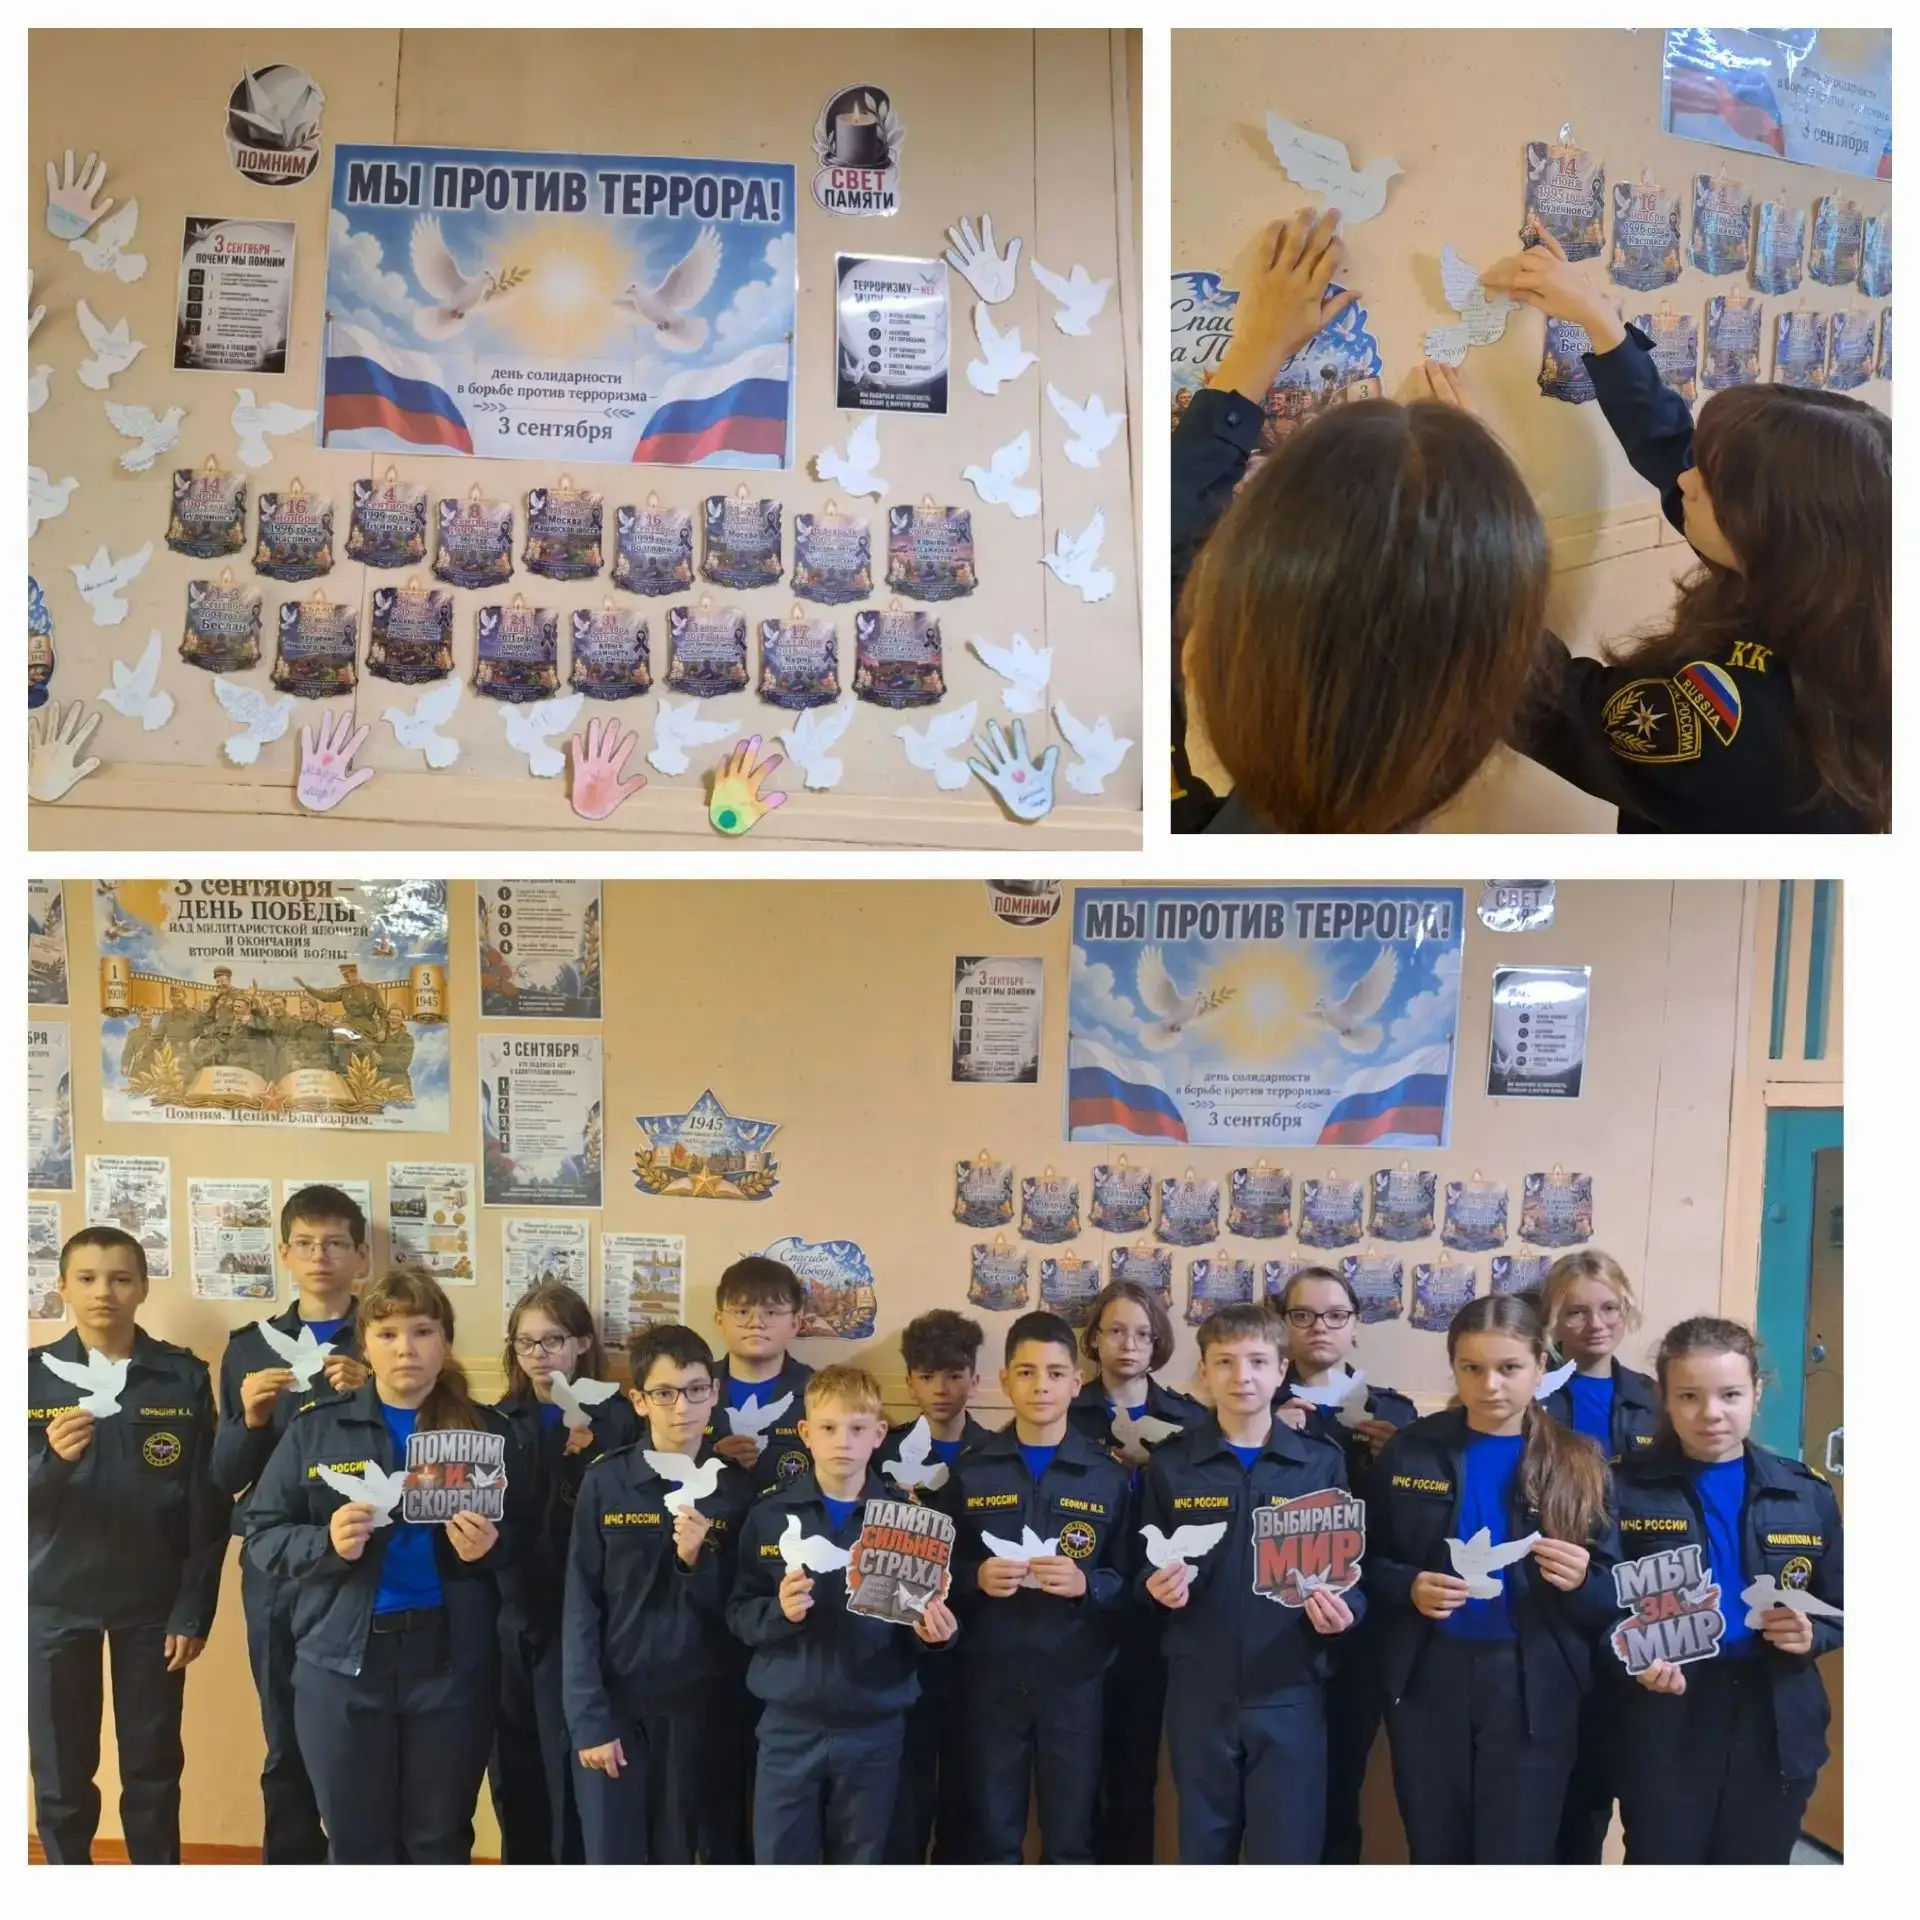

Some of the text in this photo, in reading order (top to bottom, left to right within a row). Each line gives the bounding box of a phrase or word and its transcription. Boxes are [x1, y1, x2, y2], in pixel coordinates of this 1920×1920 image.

[1801, 119, 1870, 155] 3 сентября
[236, 149, 306, 175] ПОМНИМ
[1559, 155, 1577, 176] 14
[831, 168, 886, 191] СВЕТ
[348, 163, 781, 222] МЫ ПРОТИВ ТЕРРОРА!
[823, 188, 894, 210] ПАМЯТИ
[1538, 187, 1566, 201] 1995
[1640, 193, 1656, 211] 16
[1624, 222, 1646, 235] 1996
[214, 235, 271, 255] 3 СЕНТЯБРЯ
[195, 252, 286, 268] ПОЧЕМУ МЫ ПОМНИМ
[853, 279, 936, 296] ТЕРРОРИЗМУ НЕТ
[1559, 328, 1580, 339] 2004
[491, 367, 622, 384] день солидарности
[457, 381, 647, 403] в борьбе против терроризма
[1359, 384, 1370, 398] 3
[498, 417, 614, 443] 3 сентября
[384, 487, 396, 502] 4
[287, 500, 307, 514] 16
[362, 510, 409, 522] 1999 года
[548, 516, 582, 526] Москва
[646, 514, 661, 526] 16
[270, 525, 319, 535] 1996 года
[200, 620, 247, 634] Беслан
[790, 625, 809, 639] 17
[34, 638, 42, 650] 3
[1725, 640, 1774, 673] КК
[1682, 678, 1721, 728] RUSSIA
[1676, 701, 1694, 752] РОССИИ
[175, 880, 334, 899] 3 сентября
[994, 896, 1052, 916] ПОМНИМ
[1495, 890, 1542, 907] СВЕТ
[177, 900, 357, 923] ДЕНЬ ПОБЕДЫ
[1085, 903, 1146, 939] МЫ
[1155, 903, 1285, 940] ПРОТИВ
[1295, 902, 1452, 940] ТЕРРОРА!
[168, 923, 369, 937] НАД МИЛИТАРИСТСКОЙ ЯПОНИЕЙ
[225, 936, 311, 947] И ОКОНЧАНИЯ
[188, 946, 348, 960] ВТОРОЙ МИРОВОЙ ВОЙНЫ
[110, 963, 119, 979] 1
[422, 971, 431, 986] 3
[978, 970, 987, 986] 3
[106, 988, 128, 1001] 1939
[993, 987, 1005, 996] МЫ
[415, 993, 439, 1009] 1945
[502, 1041, 580, 1058] 3 СЕНТЯБРЯ
[1203, 1072, 1311, 1084] день солидарности
[1184, 1084, 1222, 1098] борьбе
[1223, 1087, 1264, 1098] против
[1266, 1087, 1332, 1098] терроризма
[165, 1106, 374, 1126] Помним. Ценим. Благодарим.
[689, 1116, 724, 1131] 1945
[1208, 1111, 1303, 1130] 3 сентября
[780, 1247, 828, 1264] Спасибо
[410, 1433, 502, 1468] ПОМНИМ
[331, 1460, 369, 1473] РОССИИ
[444, 1464, 467, 1488] И
[1391, 1475, 1450, 1493] МЧС РОССИИ
[406, 1488, 502, 1518] СКОРБИМ
[967, 1493, 1018, 1509] МЧС РОССИИ
[1174, 1496, 1229, 1509] МЧС РОССИИ
[604, 1513, 661, 1526] МЧС РОССИИ
[863, 1500, 953, 1542] ПАМЯТЬ
[1260, 1503, 1360, 1537] ВЫБИРАЕМ
[1620, 1519, 1688, 1532] МЧС РОССИИ
[760, 1544, 780, 1556] МЧС
[861, 1525, 951, 1567] СИЛЬНЕЕ
[1259, 1530, 1362, 1588] МИР
[859, 1547, 942, 1591] СТРАХА
[1617, 1545, 1702, 1605] МЫ
[1638, 1592, 1683, 1622] ЗА
[1624, 1608, 1722, 1672] МИР
